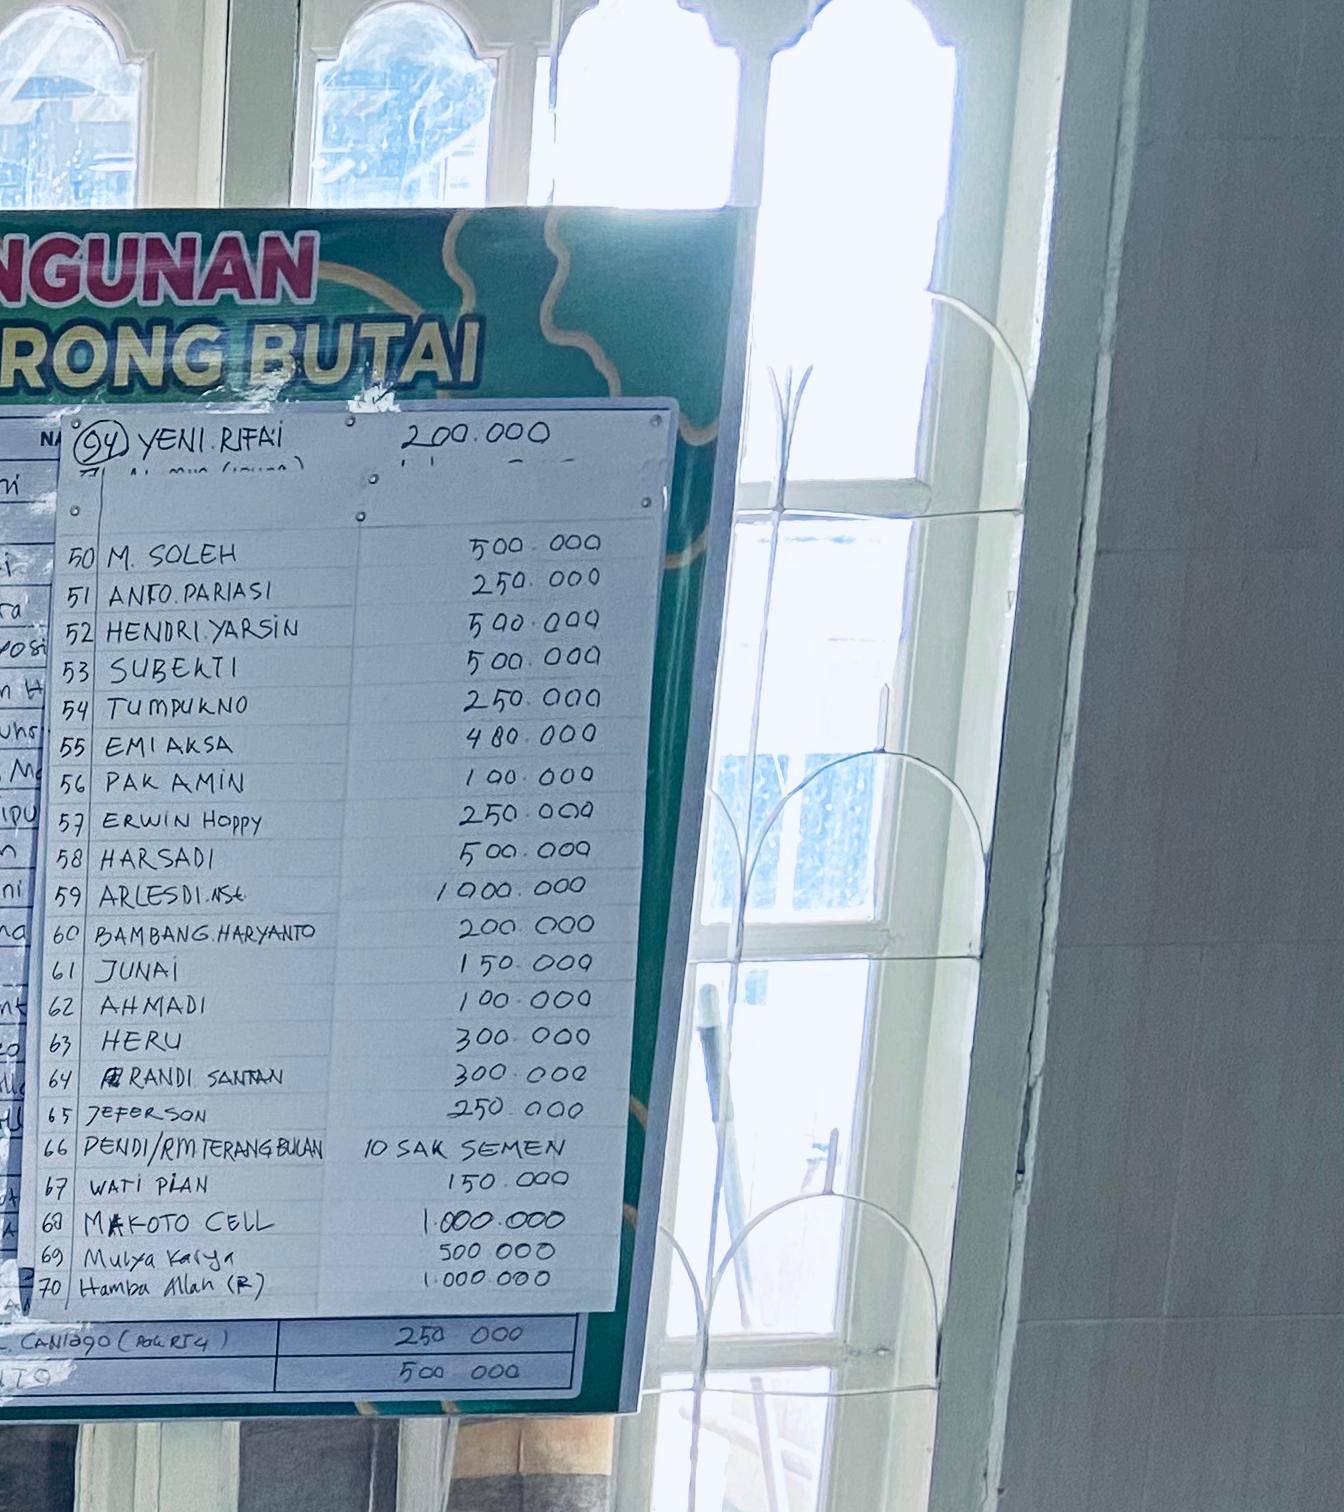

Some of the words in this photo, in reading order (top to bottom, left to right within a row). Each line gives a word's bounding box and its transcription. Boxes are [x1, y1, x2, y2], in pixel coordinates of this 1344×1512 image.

[249, 319, 481, 388] BUTAI
[67, 546, 96, 570] 50
[148, 543, 237, 567] SOLEH
[66, 586, 90, 608] 51
[65, 621, 94, 645] 52
[62, 660, 89, 684] 53
[62, 699, 89, 722] 54
[59, 736, 86, 758] 55
[59, 773, 86, 795] 56
[105, 771, 159, 792] PAK
[58, 812, 85, 838] 57
[56, 847, 83, 870] 58
[54, 885, 81, 908] 59
[53, 924, 80, 945] 60
[51, 961, 74, 981] 61
[48, 996, 74, 1017] 62
[100, 994, 206, 1018] AHMADI
[49, 1032, 72, 1057] 63
[101, 1029, 182, 1052] HERU
[48, 1069, 73, 1090] 64
[48, 1106, 73, 1124] 65
[43, 1138, 68, 1158] 66
[363, 1139, 388, 1159] 10
[461, 1138, 567, 1162] SEMEN
[44, 1175, 69, 1201] 67
[42, 1211, 63, 1233] 68
[204, 1209, 276, 1233] CELL
[41, 1245, 64, 1268] 69
[38, 1278, 62, 1299] 70
